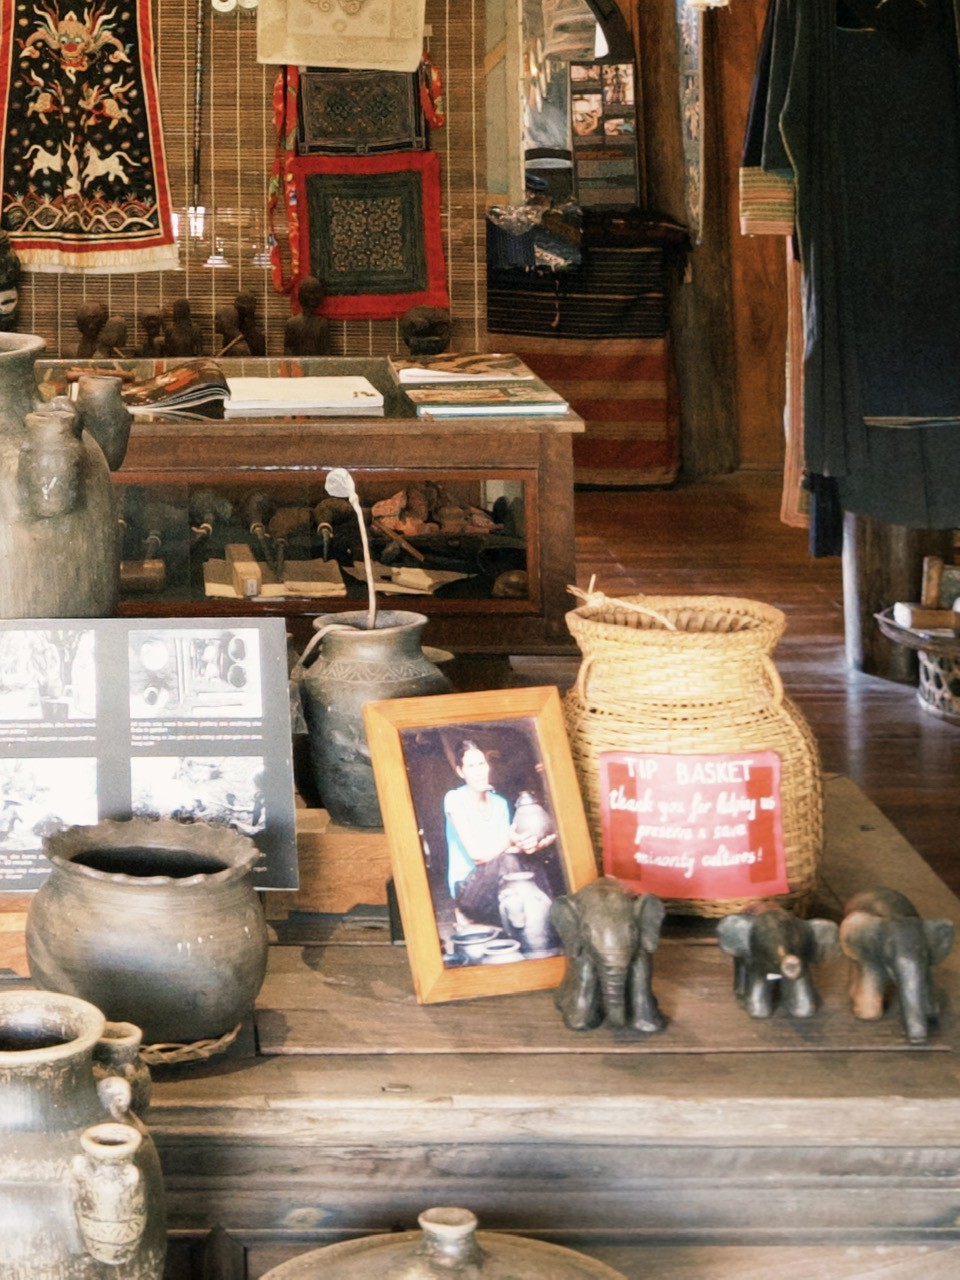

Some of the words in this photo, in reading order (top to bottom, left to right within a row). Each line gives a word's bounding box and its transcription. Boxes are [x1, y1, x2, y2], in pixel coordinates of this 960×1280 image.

[623, 756, 658, 780] TIP
[675, 759, 754, 785] BASKET
[658, 801, 685, 822] you
[688, 791, 712, 823] for
[716, 791, 756, 821] helping
[760, 796, 776, 810] us
[634, 824, 693, 845] preserve
[713, 823, 747, 839] save
[634, 851, 695, 879] minority
